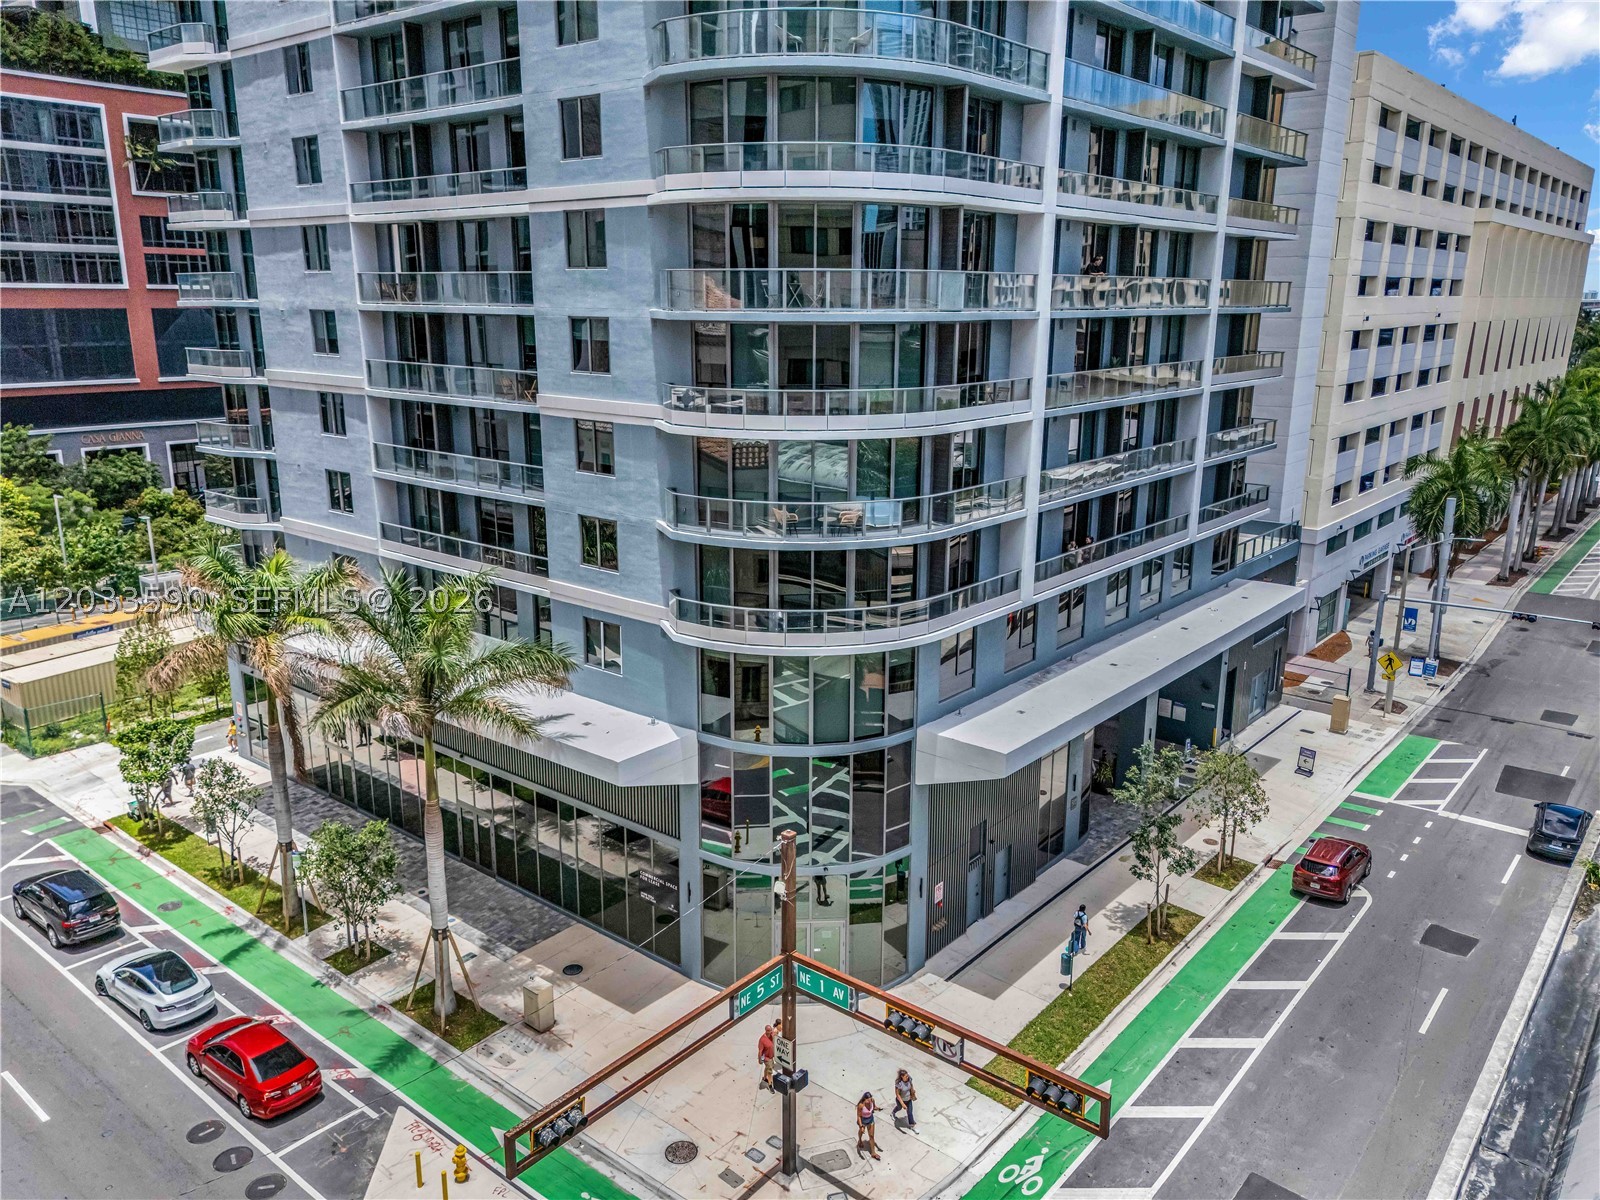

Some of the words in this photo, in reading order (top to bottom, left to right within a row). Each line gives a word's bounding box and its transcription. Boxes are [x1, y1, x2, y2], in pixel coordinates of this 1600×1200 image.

[81, 434, 106, 444] CASA
[108, 430, 145, 442] GIANNA
[640, 870, 665, 885] COMMERCIAL
[665, 881, 678, 891] SPACE
[648, 879, 660, 887] LEASE
[741, 992, 751, 1009] NE
[757, 983, 765, 999] 5
[770, 972, 780, 988] ST
[799, 971, 811, 987] NE
[820, 980, 824, 993] 1
[833, 987, 845, 1001] AV
[776, 1038, 789, 1050] ONE
[776, 1045, 790, 1057] WAY
